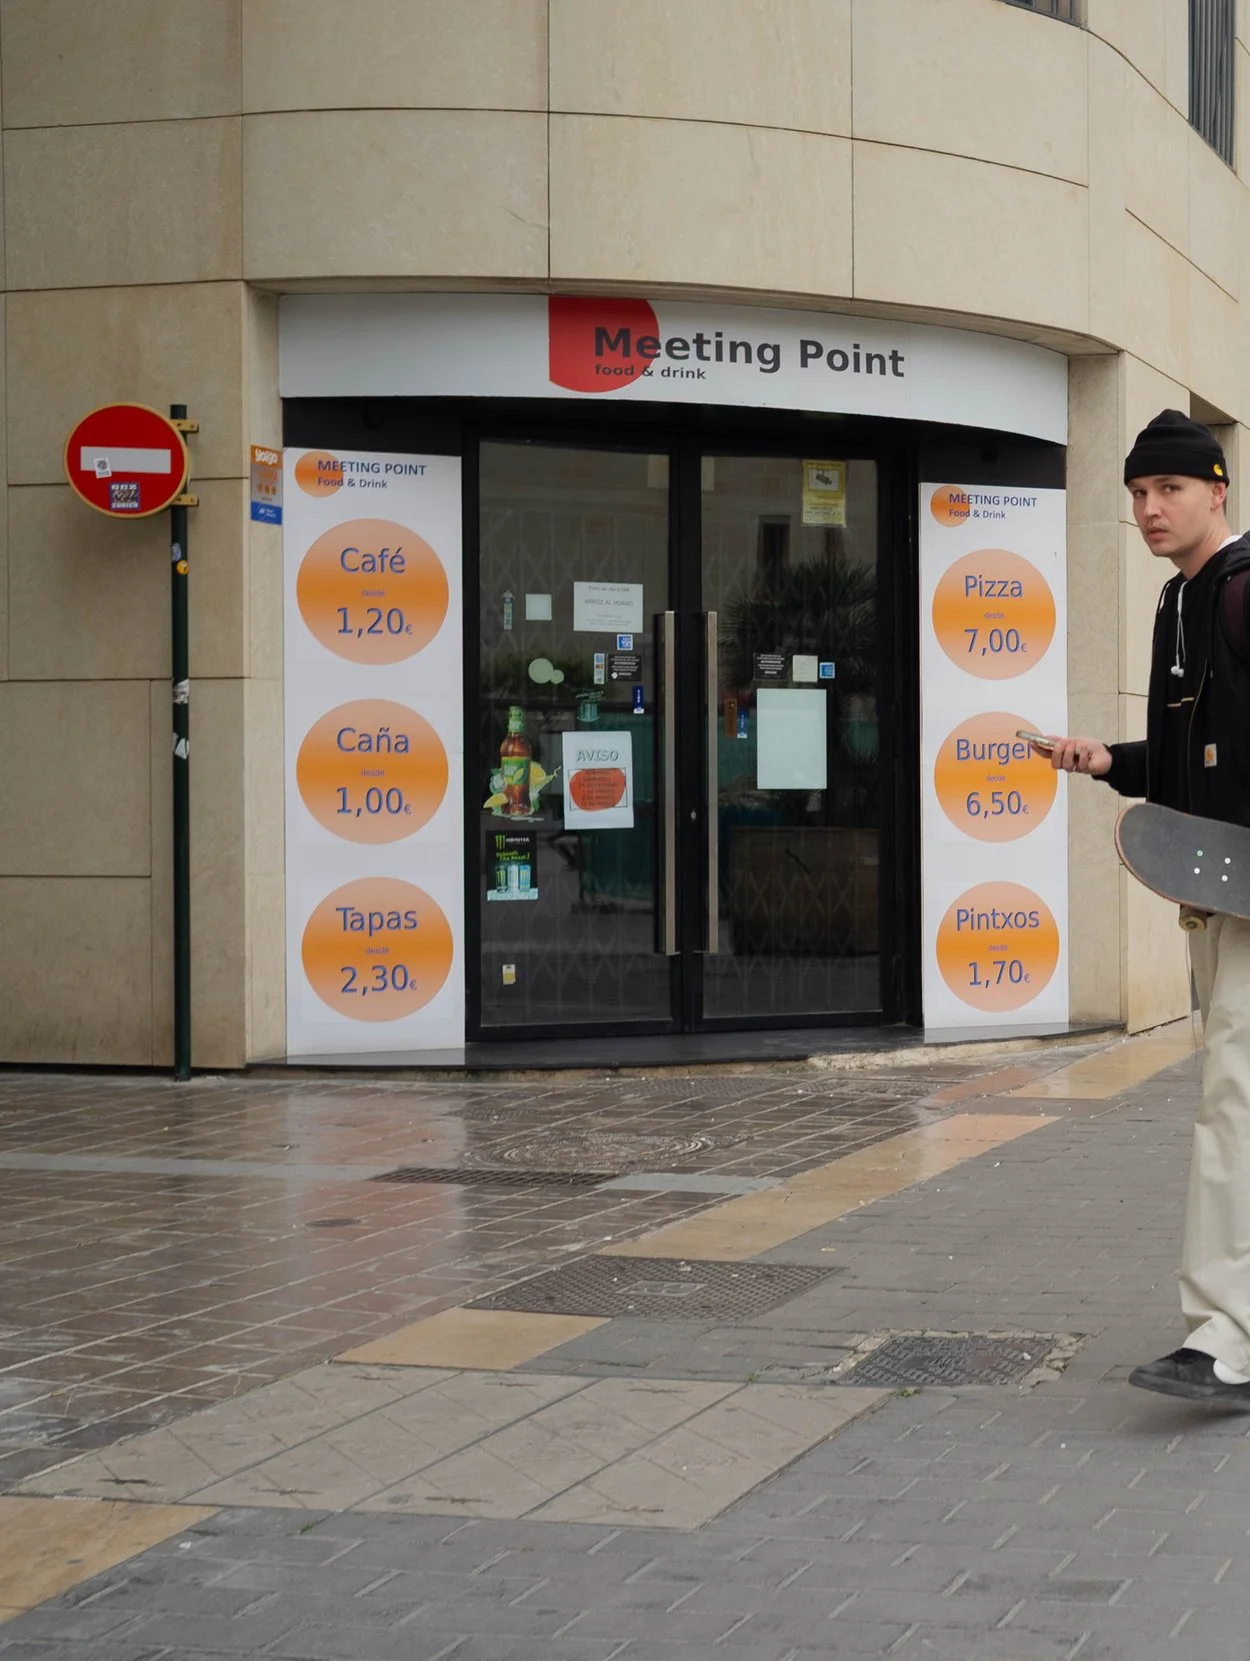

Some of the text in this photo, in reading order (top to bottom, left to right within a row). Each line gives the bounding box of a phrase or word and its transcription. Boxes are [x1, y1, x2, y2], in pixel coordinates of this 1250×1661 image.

[594, 326, 905, 377] Meeting Point
[595, 363, 706, 380] food & drink
[317, 460, 427, 476] MEETING POINT
[317, 477, 388, 489] Food & Drink
[949, 493, 1038, 507] MEETING POINT
[949, 509, 1006, 519] Food & Drink
[340, 547, 406, 574] Café
[964, 574, 1023, 598] Pizza
[337, 607, 413, 638] 1,20€
[964, 628, 1028, 656] 7,00€
[336, 727, 410, 753] Caña
[956, 738, 1032, 766] Burger
[576, 749, 619, 762] AVISO
[360, 768, 385, 777] desde
[336, 787, 412, 818] 1,00€
[966, 790, 1030, 819] 6,50€
[335, 907, 418, 937] Tapas
[956, 907, 1040, 932] Pintxos
[340, 964, 418, 996] 2,30€
[968, 959, 1031, 989] 1,70€
